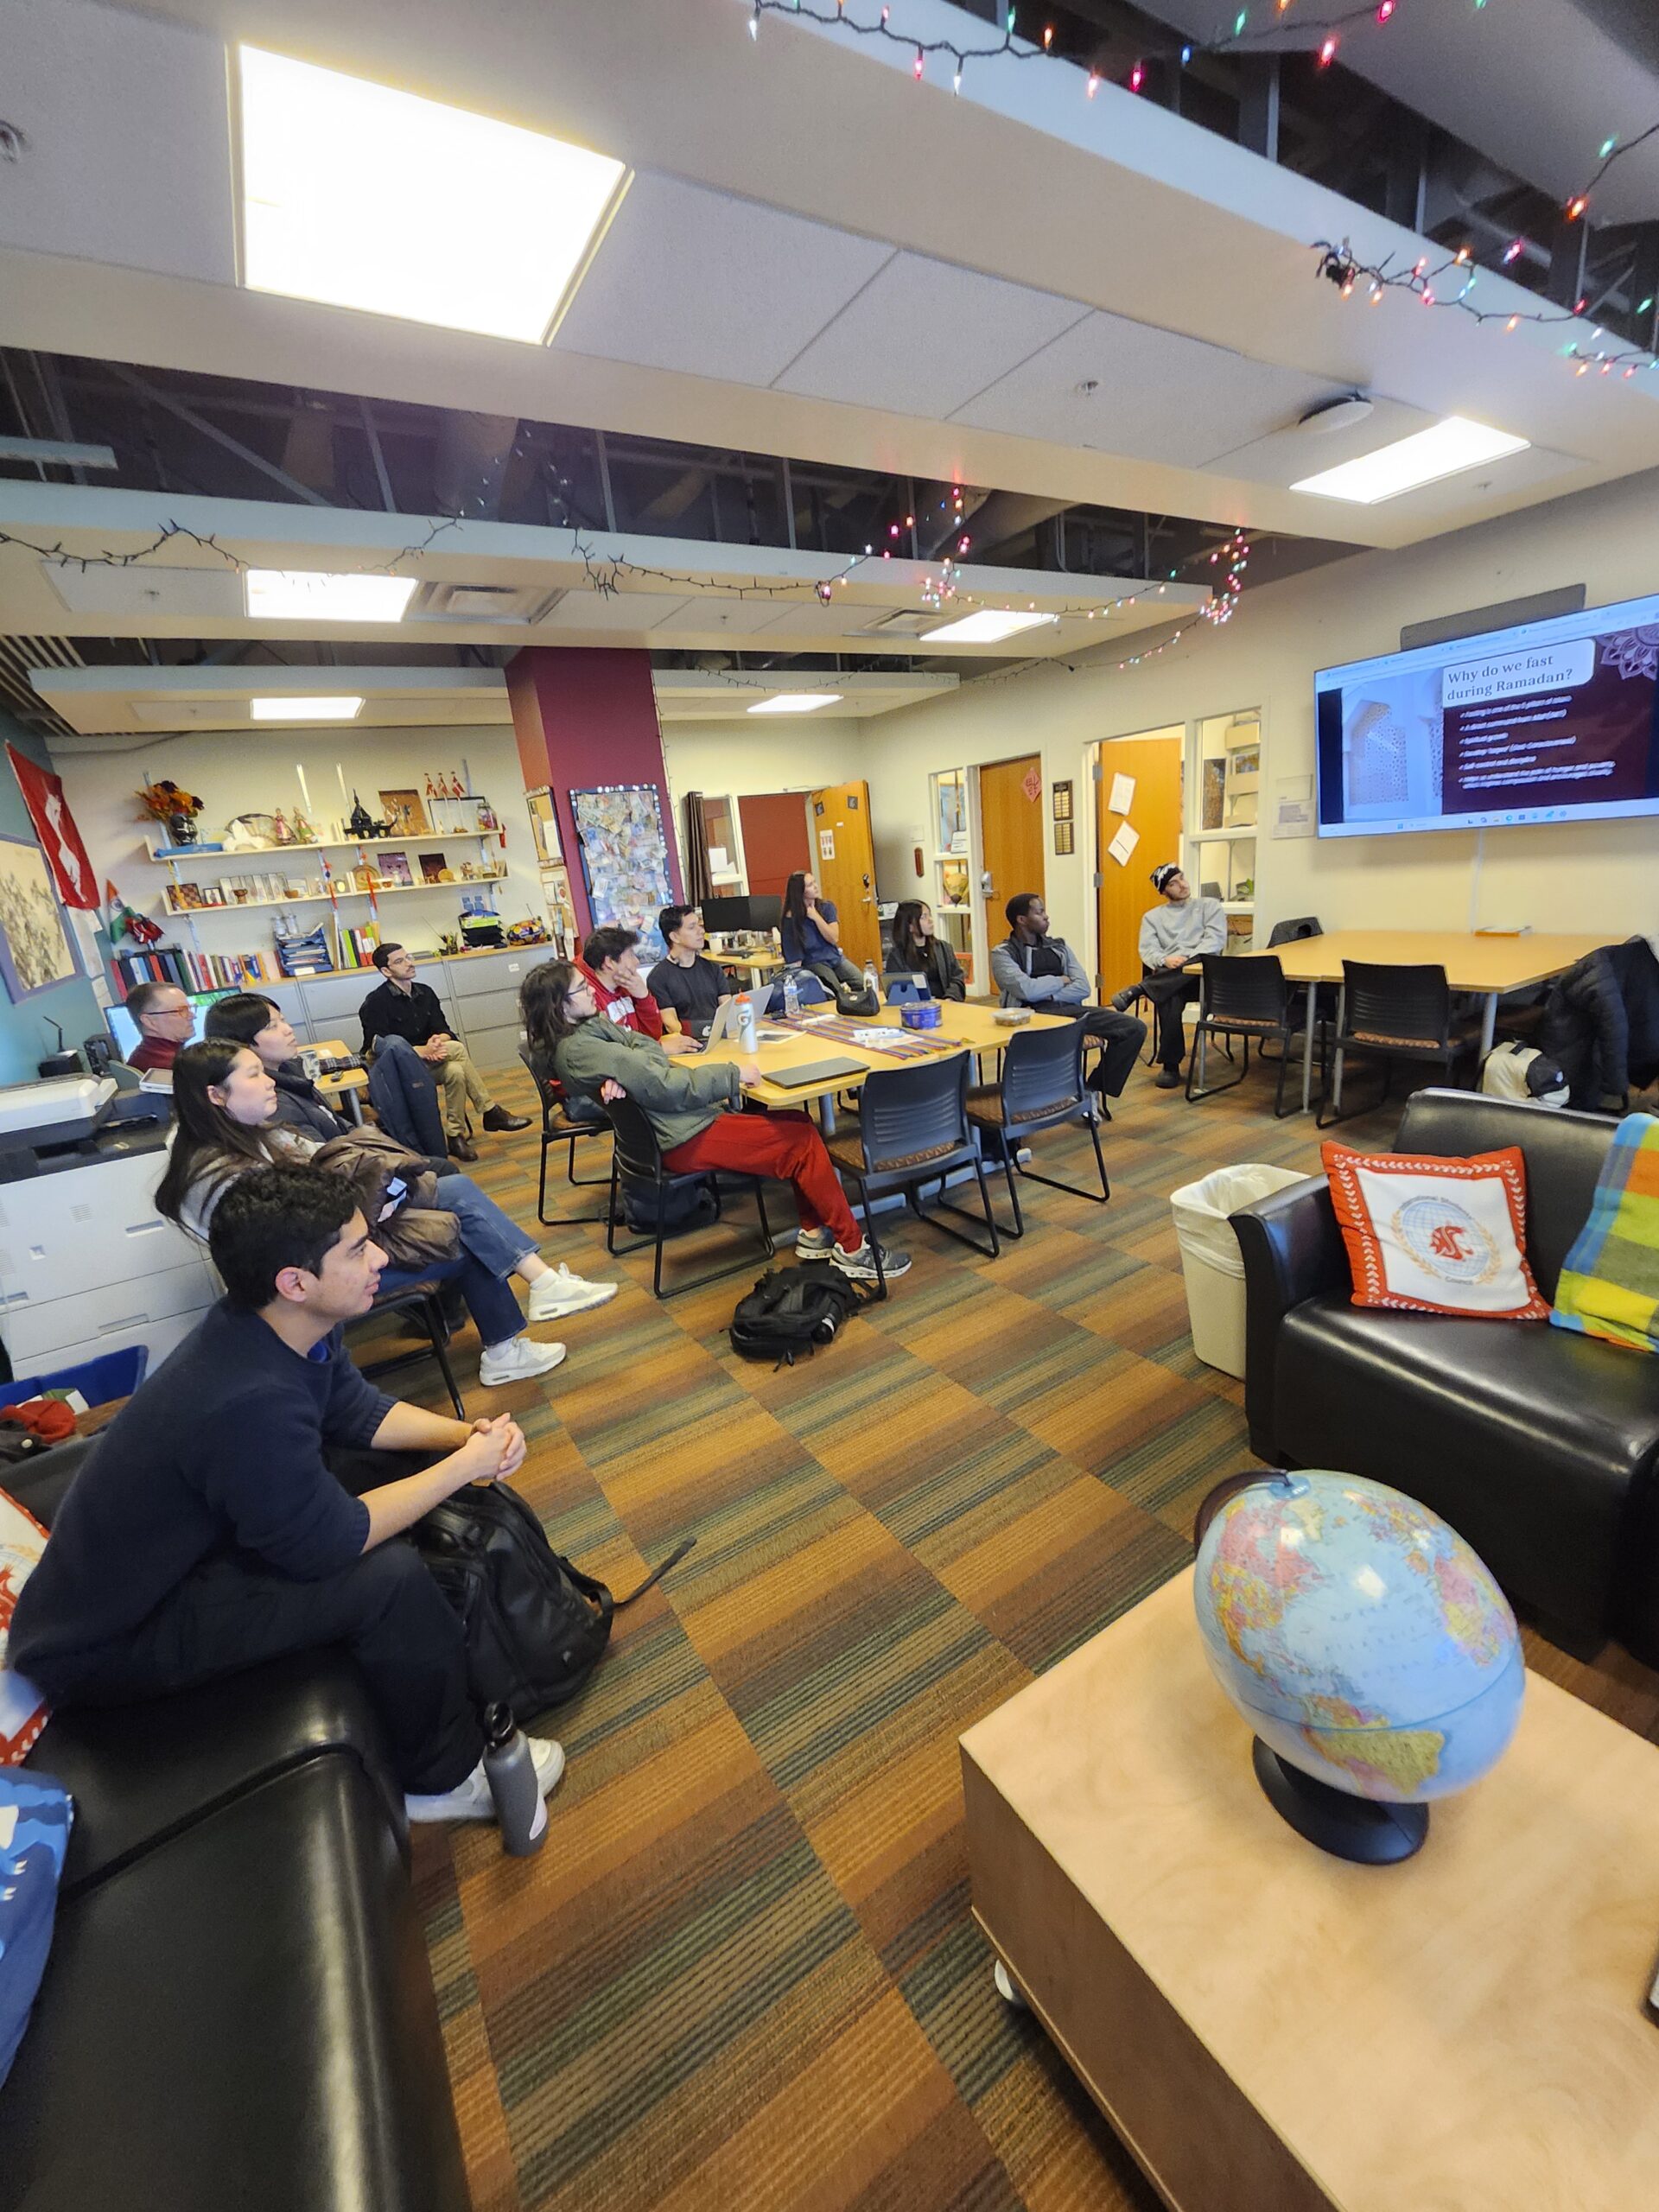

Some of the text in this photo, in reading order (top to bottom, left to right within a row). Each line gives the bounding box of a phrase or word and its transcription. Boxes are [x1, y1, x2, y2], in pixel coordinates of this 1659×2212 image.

[1448, 656, 1554, 683] Why do we fast
[1447, 669, 1573, 701] during Ramadan?
